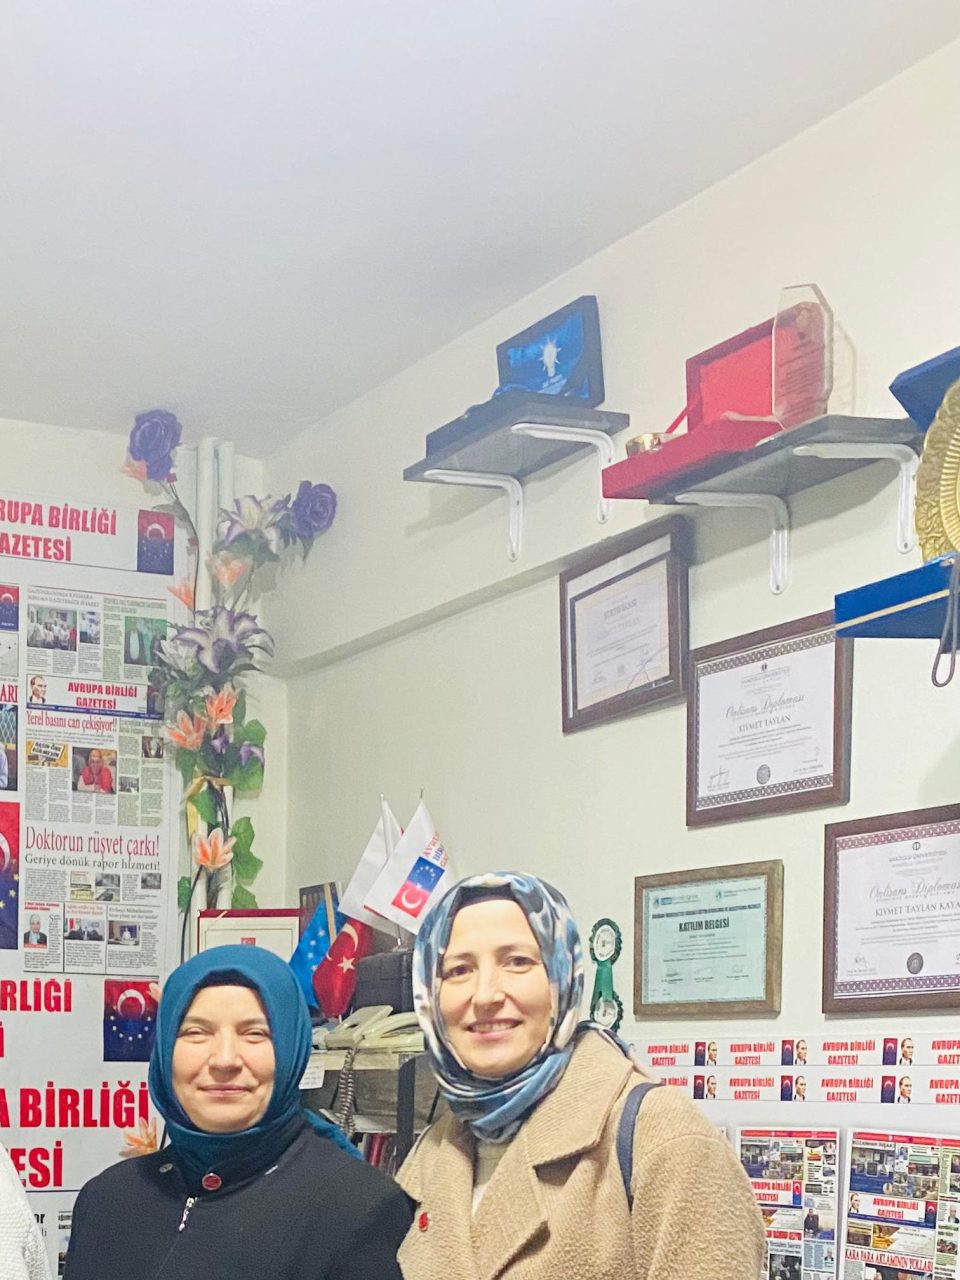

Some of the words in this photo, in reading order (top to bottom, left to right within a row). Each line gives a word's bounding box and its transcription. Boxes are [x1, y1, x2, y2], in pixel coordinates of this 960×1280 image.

[48, 503, 117, 536] BİRLİĞİ
[67, 682, 104, 695] AVRUPA
[105, 683, 138, 698] BİRLİĞİ
[75, 697, 117, 710] GAZETESİ
[26, 710, 44, 726] Yerel
[68, 719, 81, 729] can
[25, 825, 84, 853] Doktorun
[87, 830, 123, 859] rüşvet
[24, 853, 57, 868] Geriye
[92, 859, 120, 871] rapor
[875, 906, 903, 917] KIYMET
[905, 903, 937, 915] TAYLAN
[678, 920, 704, 933] KATILIM
[704, 916, 730, 930] BELGESİ
[647, 1045, 668, 1054] AVRUPA
[730, 1043, 752, 1053] AVRUPA
[753, 1041, 775, 1053] BİRLİĞİ
[822, 1041, 849, 1052] AVRUPA
[850, 1040, 876, 1051] BİRLİĞİ
[734, 1055, 761, 1065] GAZETESİ
[827, 1054, 859, 1065] GAZETESİ
[937, 1054, 960, 1065] GAZET
[729, 1077, 752, 1087] AVRUPA
[752, 1076, 775, 1088] BİRLİĞİ
[821, 1078, 847, 1088] AVRUPA
[848, 1077, 874, 1088] BİRLİĞİ
[929, 1079, 960, 1089] AVRUPA
[734, 1090, 760, 1100] GAZETESİ
[826, 1091, 857, 1102] GAZETESİ
[935, 1093, 960, 1104] GAZET
[19, 1081, 149, 1129] BİRLİĞİ
[873, 1197, 896, 1208] AVRUPA
[877, 1208, 904, 1219] GAZETESİ
